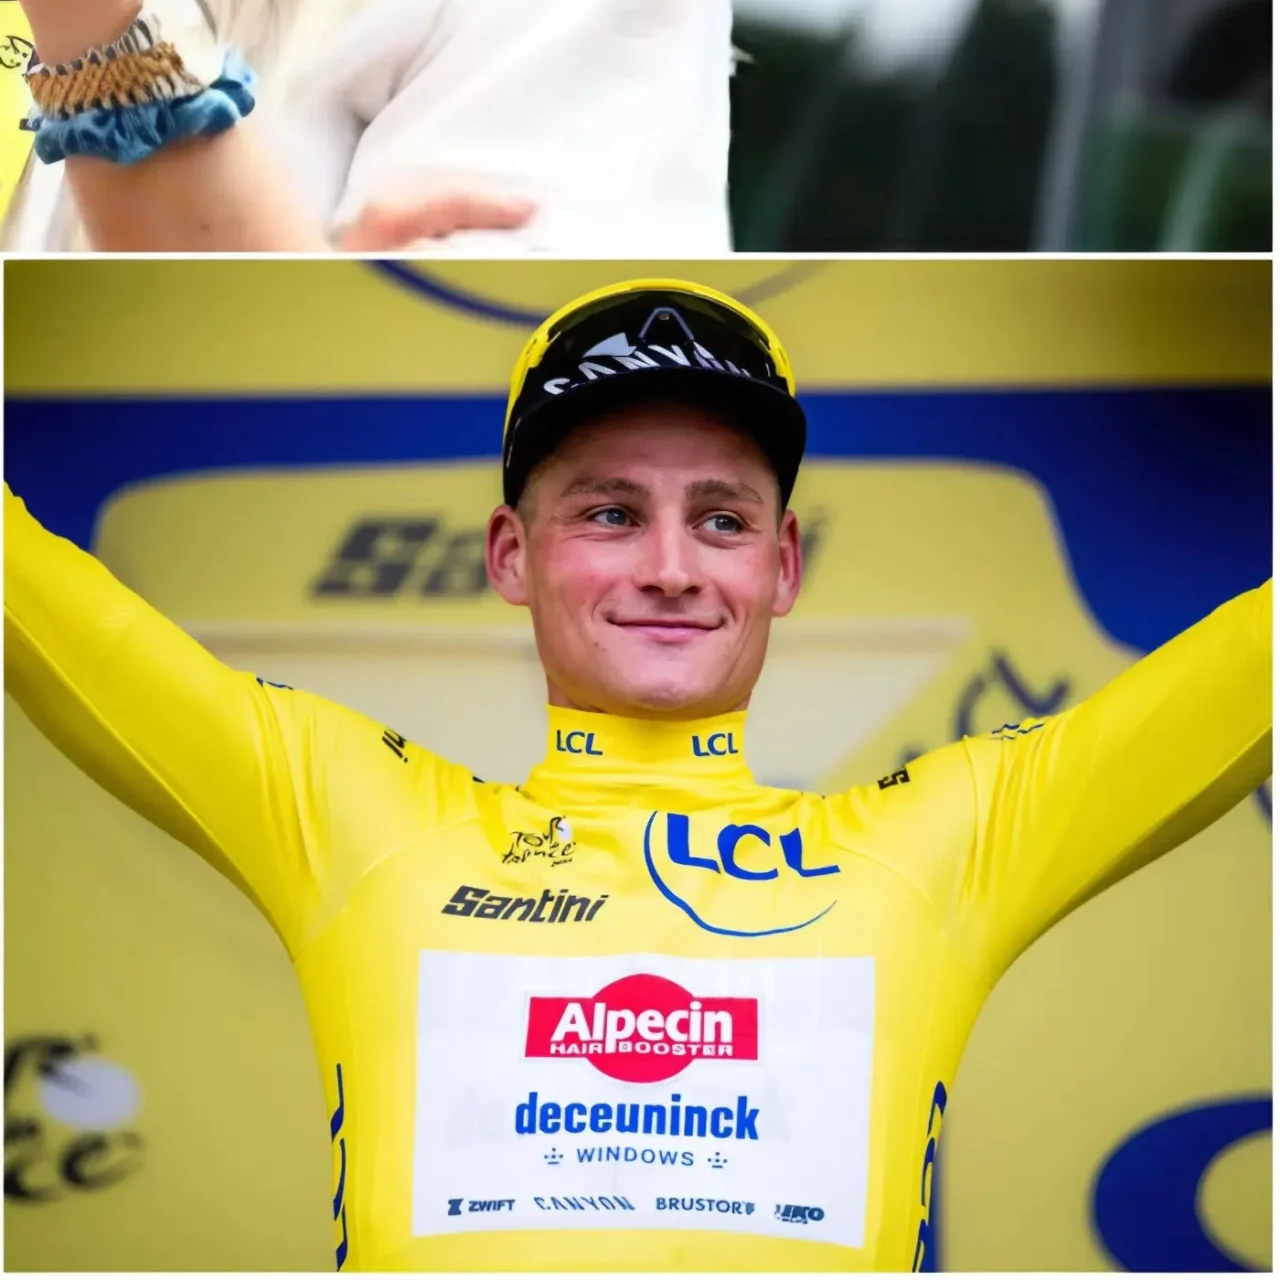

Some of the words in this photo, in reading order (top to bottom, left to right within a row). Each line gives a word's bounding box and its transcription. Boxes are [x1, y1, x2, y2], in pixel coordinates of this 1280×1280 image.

[556, 729, 604, 756] LCL
[691, 732, 739, 757] LCL
[667, 812, 841, 881] LCL
[441, 885, 609, 924] Santini
[551, 1001, 733, 1054] Alpecin
[550, 1043, 602, 1055] HAIR
[618, 1042, 733, 1056] BOOSTER
[515, 1091, 760, 1140] deceuninck
[577, 1146, 694, 1166] WINDOWS
[469, 1199, 516, 1212] ZWIFT
[534, 1196, 636, 1211] CANYON
[656, 1197, 743, 1215] BRUSTOR
